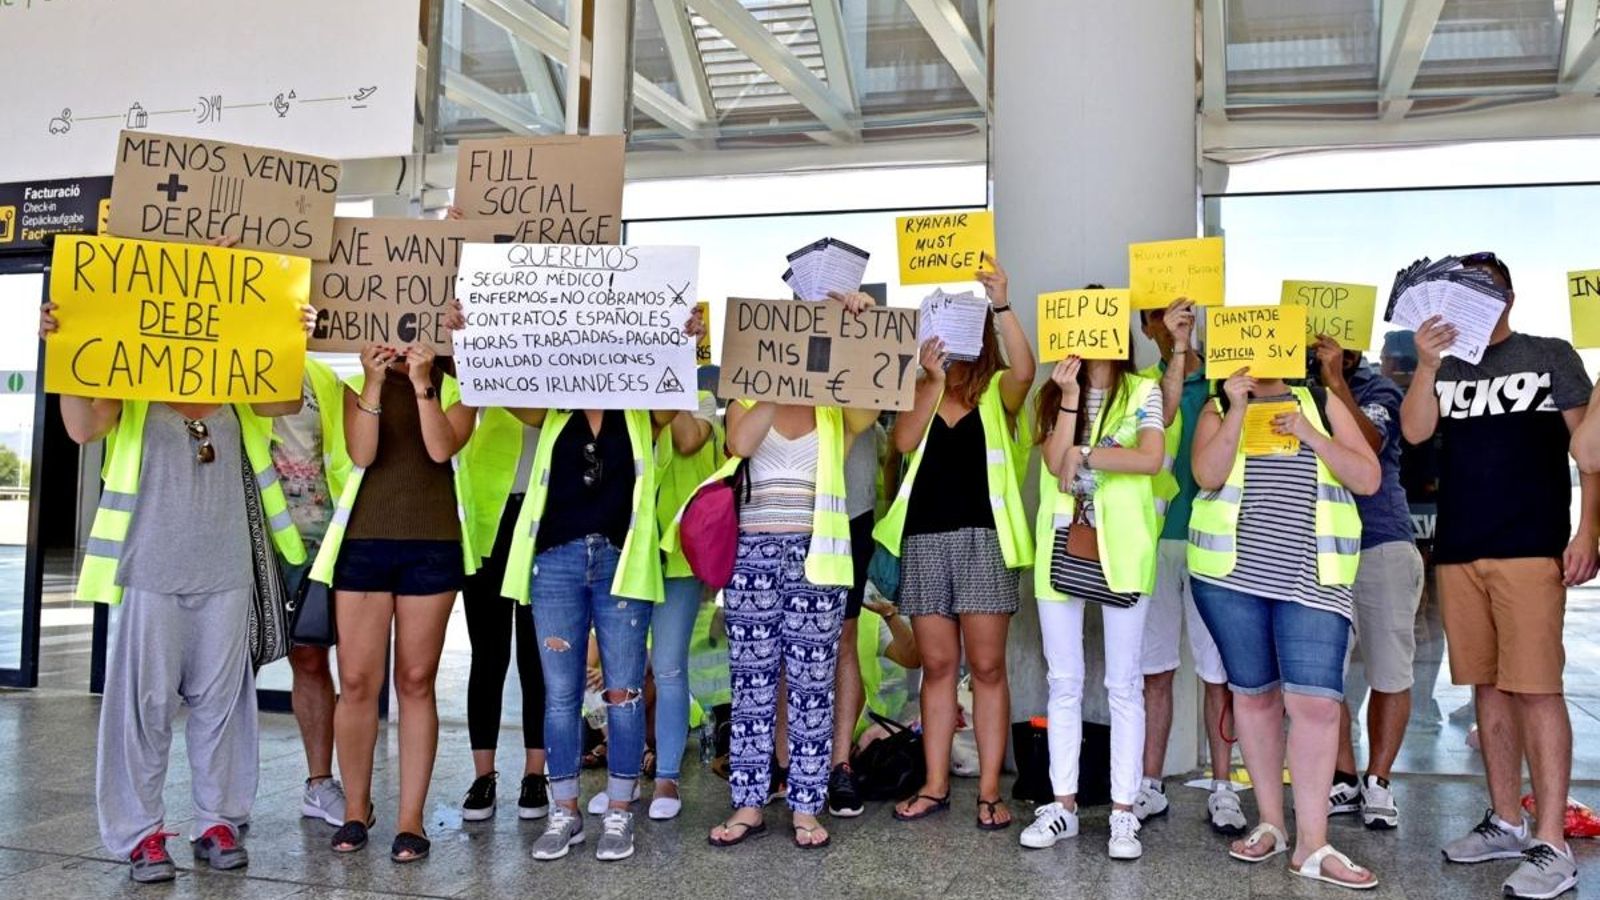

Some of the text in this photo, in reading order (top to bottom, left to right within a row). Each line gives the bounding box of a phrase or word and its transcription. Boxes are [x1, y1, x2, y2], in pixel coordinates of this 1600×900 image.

[122, 136, 339, 194] MENOS VENTAS
[469, 148, 538, 182] FULL
[24, 184, 81, 199] Facturació
[478, 183, 587, 216] SOCIAL
[23, 202, 57, 213] Check-in
[141, 204, 313, 249] DERECHOS
[905, 213, 968, 233] RYANAIR
[329, 226, 466, 267] WE WANT
[915, 232, 956, 251] MUST
[507, 244, 639, 272] QUEREMOS
[74, 240, 267, 305] RYANAIR
[471, 271, 538, 287] SEGURO
[322, 272, 387, 302] OUR
[587, 290, 666, 306] COBRAMOS
[1296, 286, 1349, 310] STOP
[139, 299, 221, 338] DEBE
[466, 307, 671, 328] CONTRATOS ESPAÑOLES
[1045, 295, 1119, 321] HELP US
[1214, 309, 1280, 327] CHANTAJE
[738, 302, 828, 334] DONDE
[840, 306, 917, 344] ESTAN
[1241, 325, 1262, 340] NO
[463, 333, 518, 351] HORAS
[758, 339, 800, 366] MIS
[1208, 344, 1282, 359] JUSTICIA SI
[71, 337, 278, 397] CAMBIAR
[466, 352, 656, 369] IGUALDAD CONDICIONES
[472, 375, 539, 393] BANCOS
[546, 372, 649, 393] IRLANDESES
